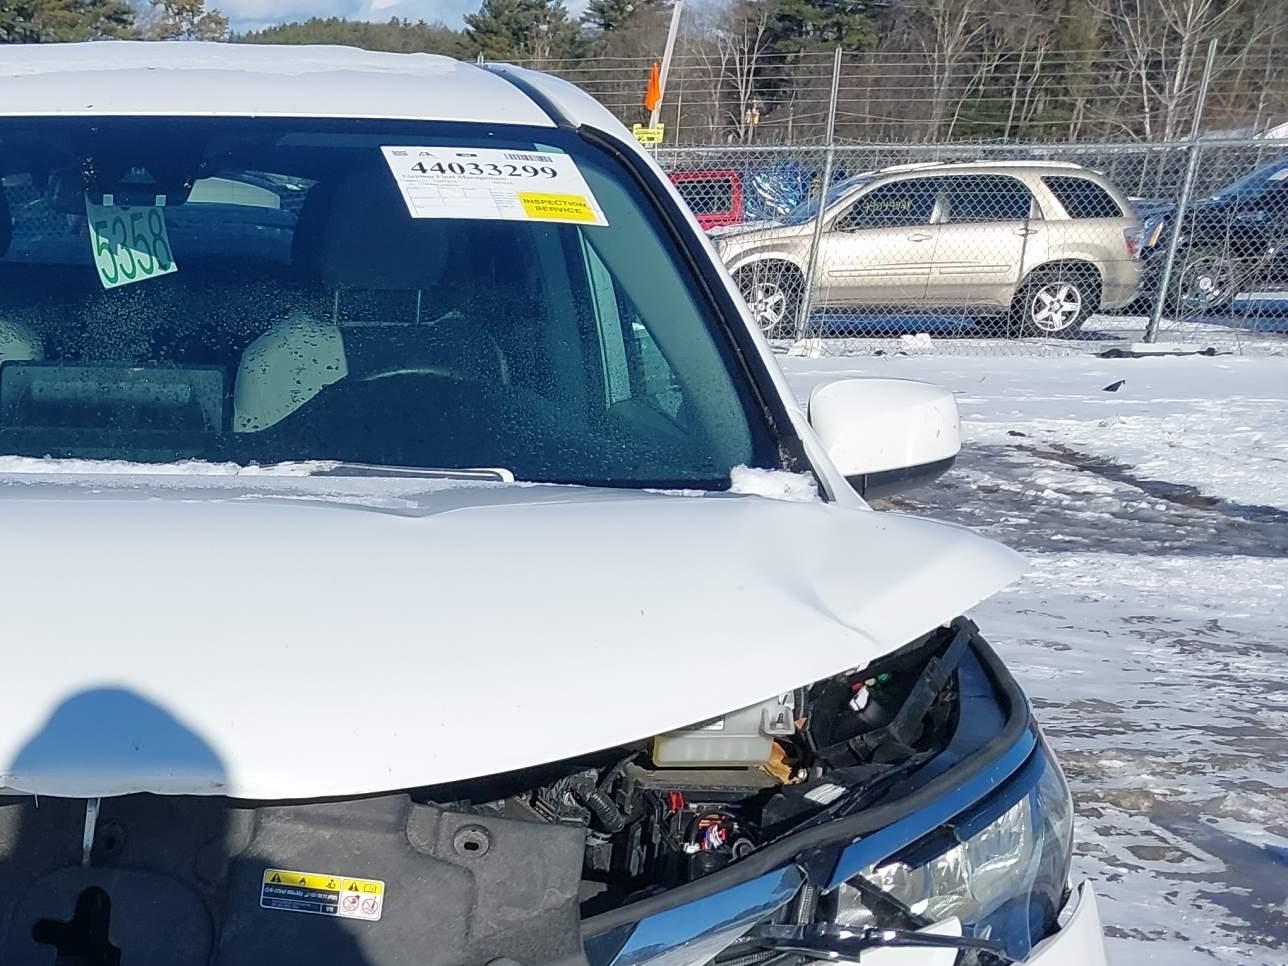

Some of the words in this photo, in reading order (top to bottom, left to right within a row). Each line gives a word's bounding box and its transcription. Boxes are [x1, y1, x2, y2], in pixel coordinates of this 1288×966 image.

[411, 161, 558, 179] 44033299
[523, 199, 587, 208] INSPECTION
[535, 206, 583, 214] SERVICE
[95, 207, 172, 284] 5358
